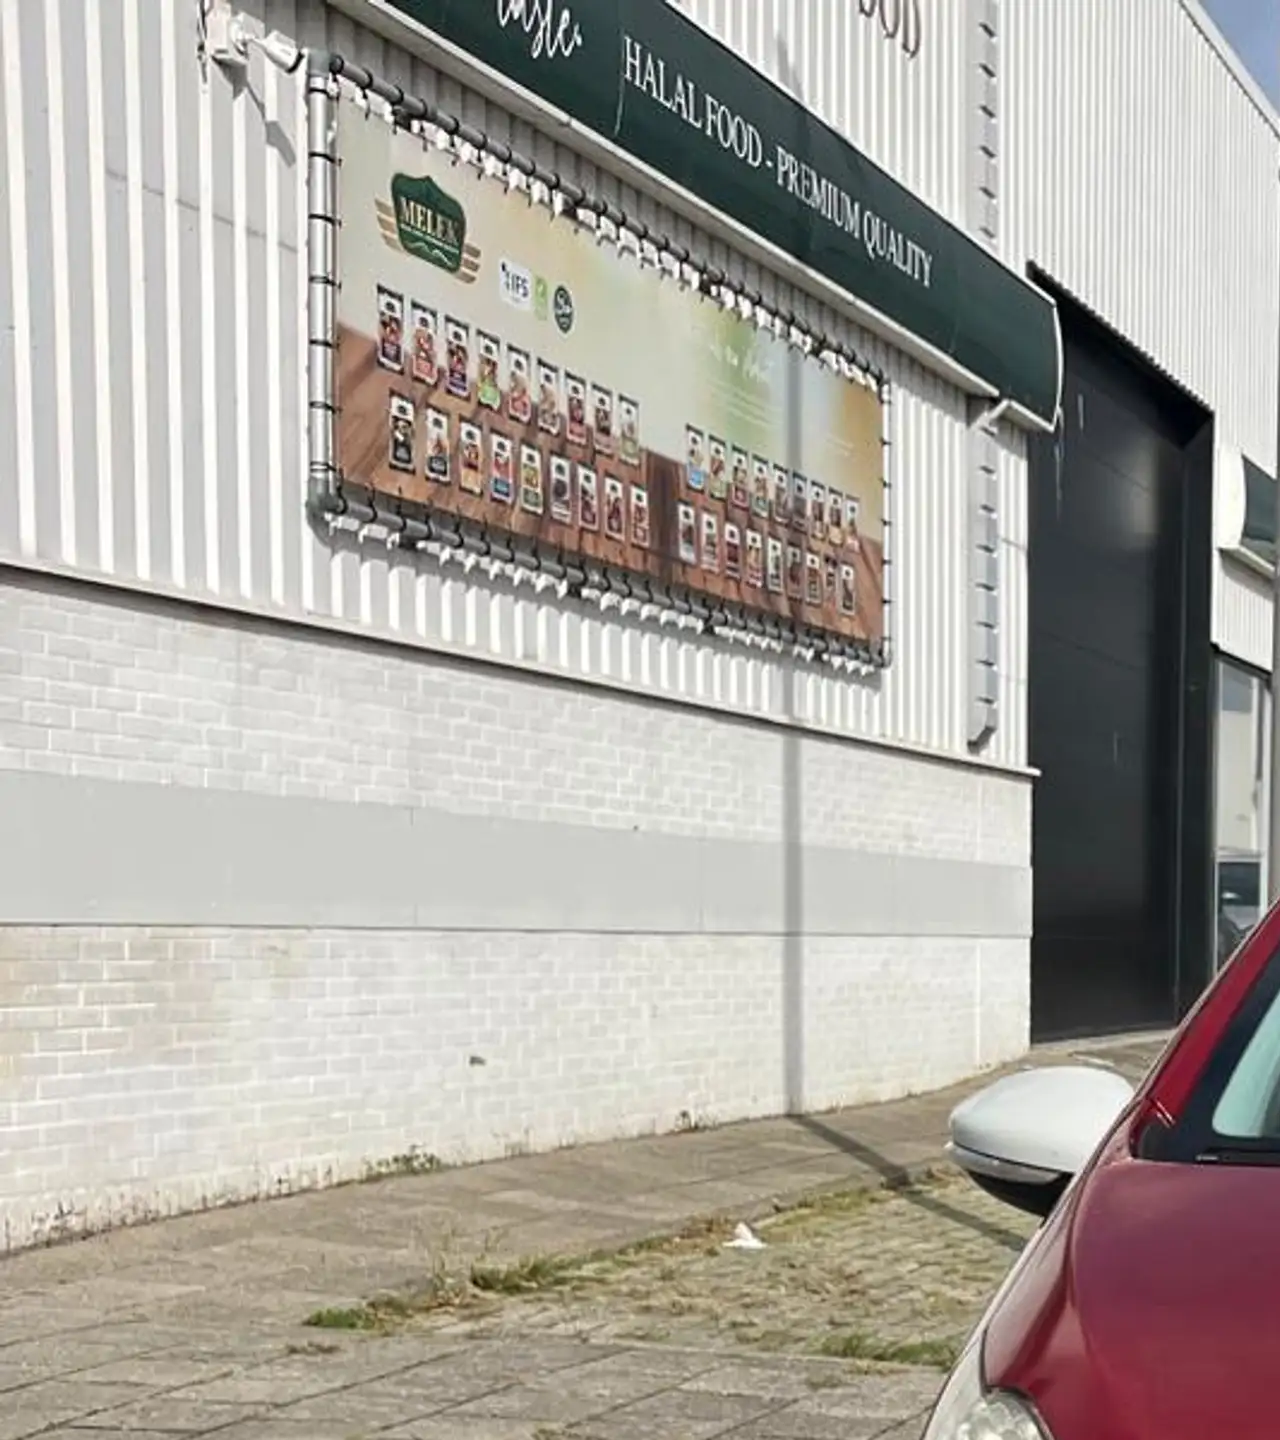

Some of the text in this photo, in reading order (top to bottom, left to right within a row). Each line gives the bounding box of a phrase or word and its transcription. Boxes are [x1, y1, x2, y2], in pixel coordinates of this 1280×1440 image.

[623, 35, 701, 129] HALAL
[705, 95, 763, 167] FOOD
[776, 144, 860, 240] PREMIUM
[863, 207, 934, 288] QUALITY
